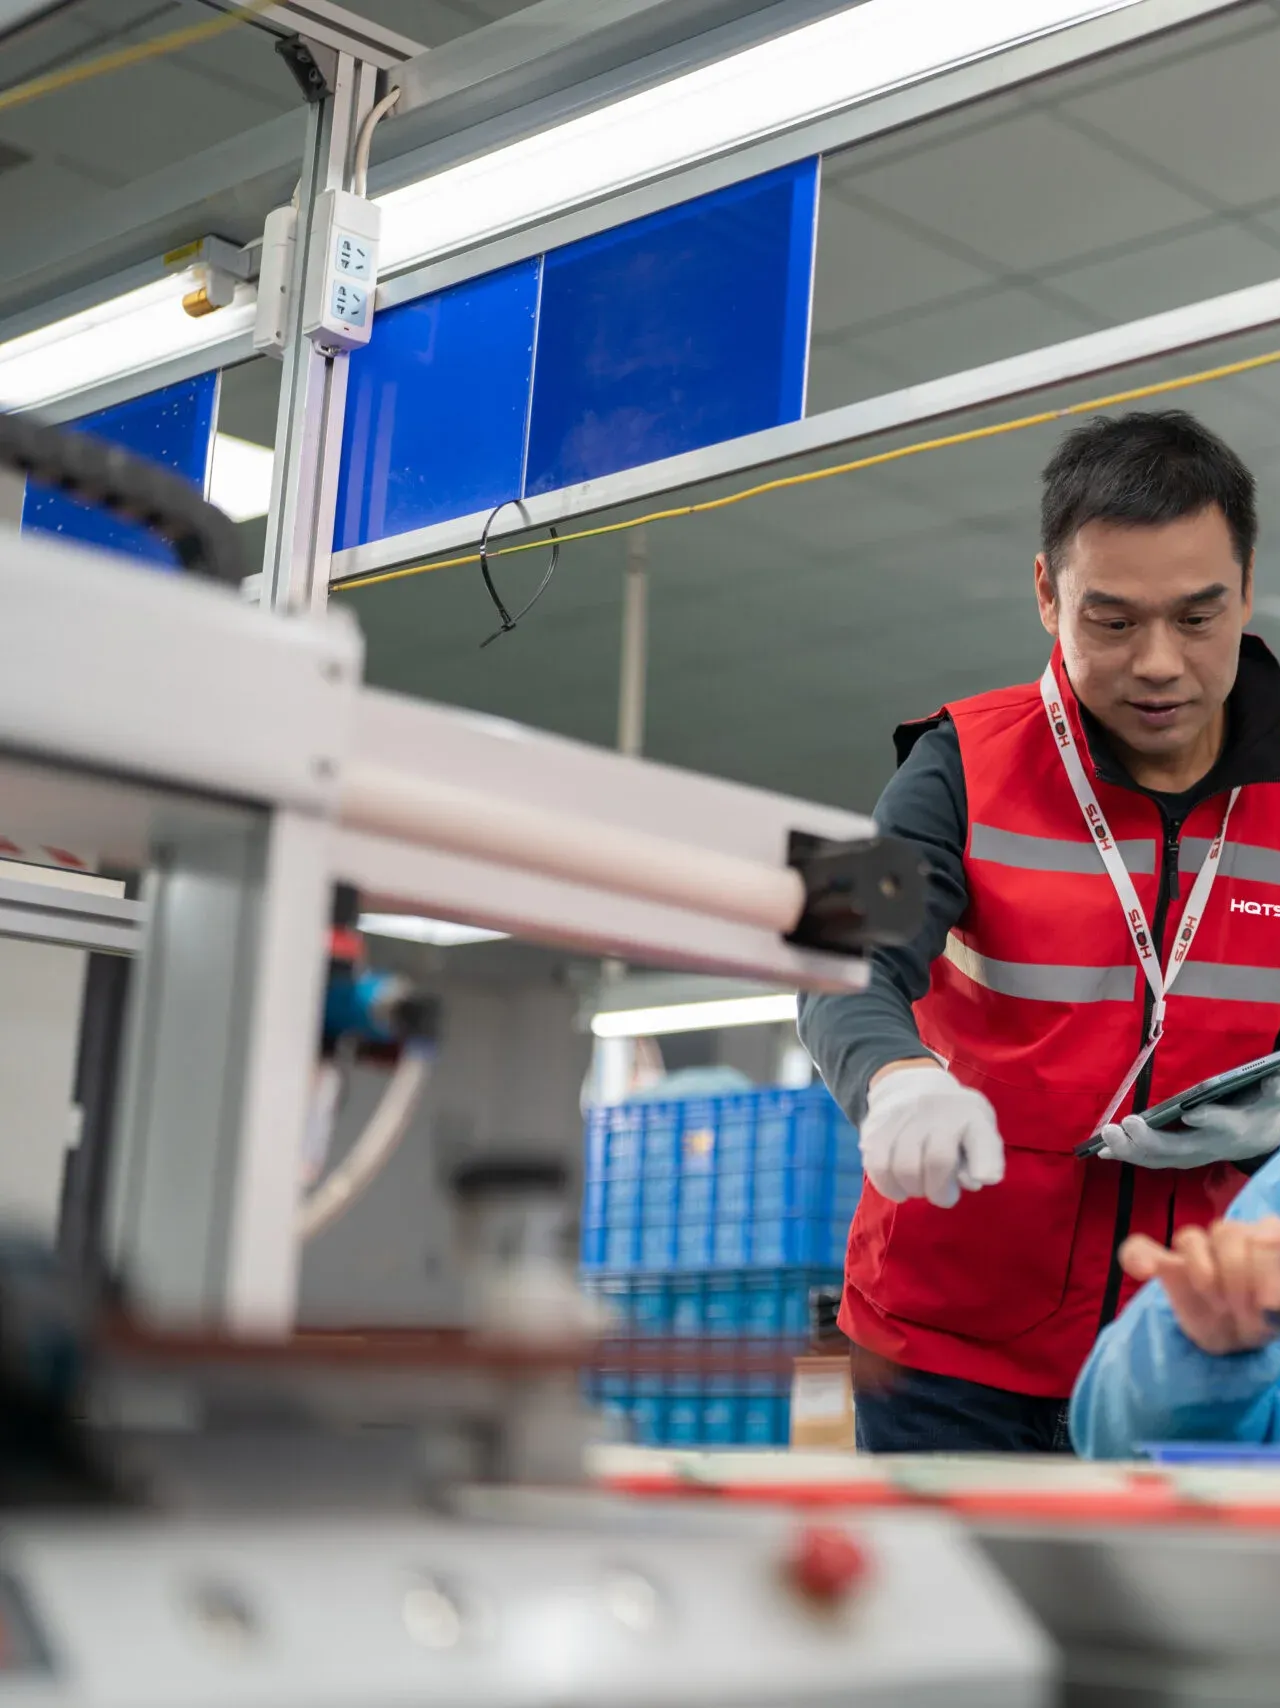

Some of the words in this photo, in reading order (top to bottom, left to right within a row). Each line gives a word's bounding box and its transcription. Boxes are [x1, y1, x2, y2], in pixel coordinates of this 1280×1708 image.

[1049, 702, 1070, 747] HQTS
[1085, 803, 1112, 851] HQTS
[1128, 909, 1152, 960] HQTS
[1175, 915, 1198, 963] HQTS
